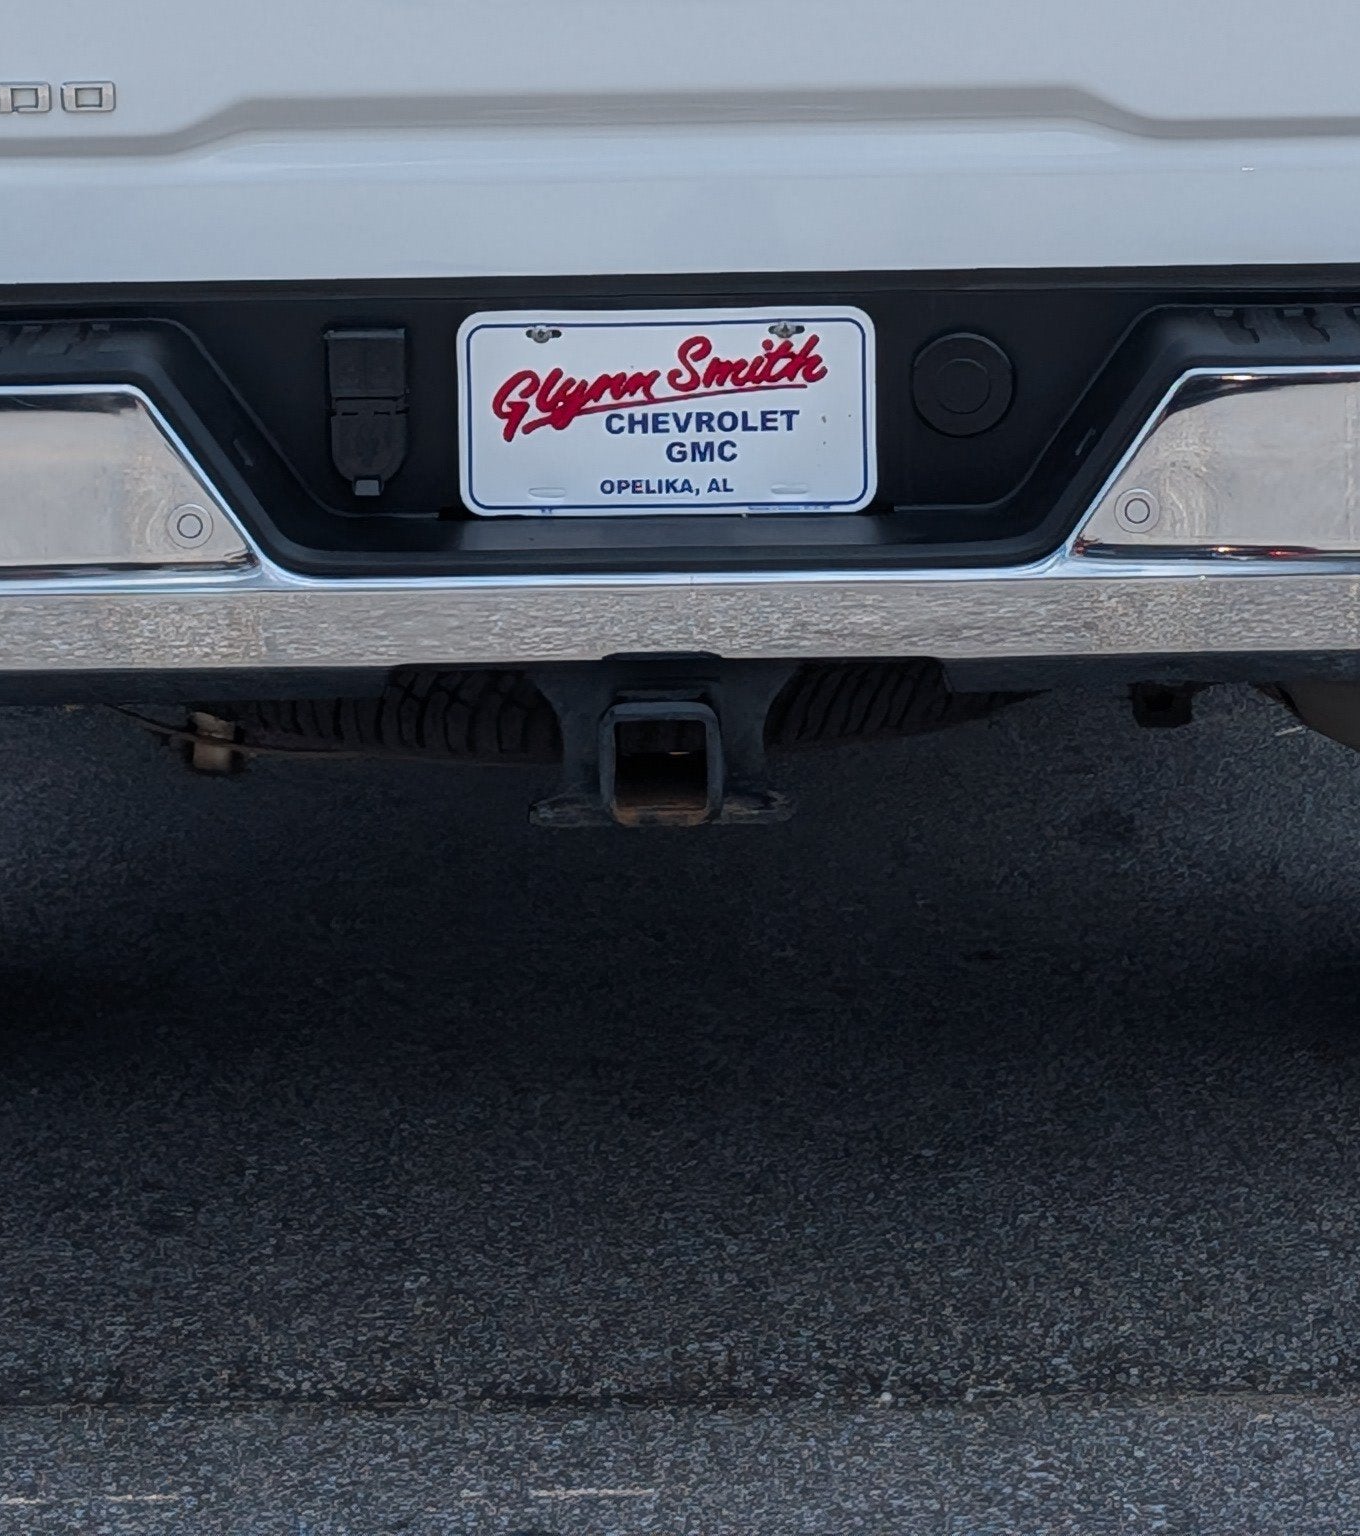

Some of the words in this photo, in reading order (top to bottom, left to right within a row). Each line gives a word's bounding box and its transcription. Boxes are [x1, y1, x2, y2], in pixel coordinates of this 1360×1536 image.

[492, 367, 660, 442] Glynn
[665, 334, 829, 393] Smith
[604, 409, 801, 435] CHEVROLET
[665, 440, 739, 463] GMC
[599, 479, 701, 496] OPELIKA,
[706, 477, 735, 494] AL
